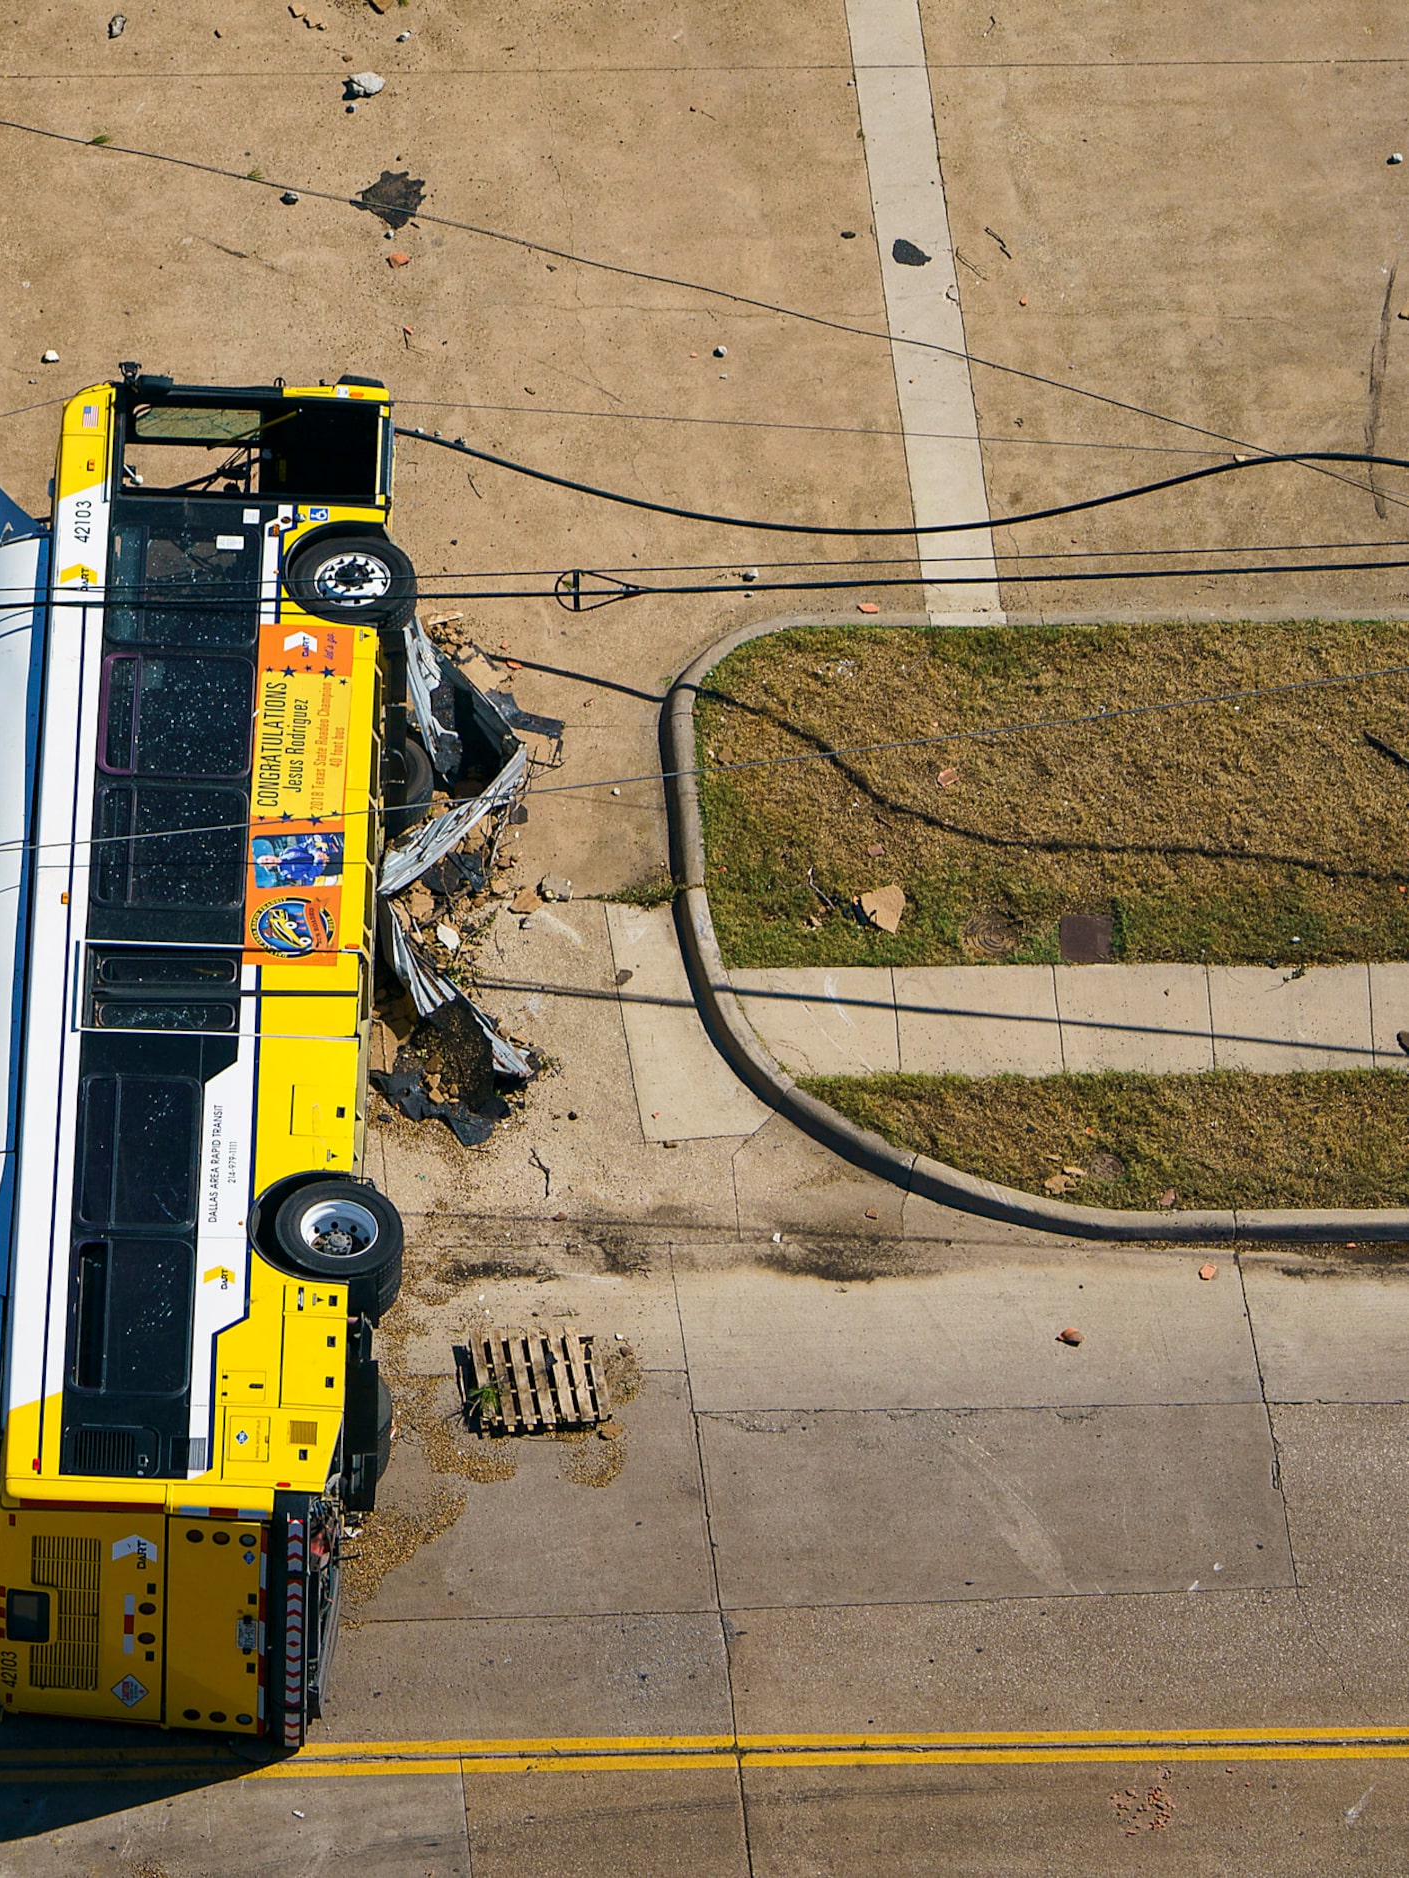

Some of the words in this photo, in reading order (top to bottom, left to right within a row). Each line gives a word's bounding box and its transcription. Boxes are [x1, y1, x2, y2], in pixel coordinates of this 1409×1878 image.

[73, 500, 92, 543] 42103
[301, 636, 310, 657] DART
[317, 681, 334, 717] Champion
[284, 698, 311, 755] Rodriguez
[315, 718, 330, 746] Roadeo
[331, 726, 345, 740] bus
[256, 681, 288, 807] CONGRATULATIONS
[313, 747, 328, 766] State
[330, 741, 344, 757] foot
[282, 759, 304, 793] Jesus
[329, 758, 343, 768] 40
[312, 768, 326, 789] Texas
[309, 791, 324, 811] 2018
[211, 1104, 223, 1137] TRANSIT
[210, 1139, 221, 1165] RAPID
[227, 1141, 238, 1184] 214-979-1111
[209, 1167, 220, 1190] AREA
[207, 1191, 219, 1223] DALLAS
[220, 1268, 228, 1290] DART
[136, 1539, 147, 1570] DART
[0, 1650, 17, 1688] 42103
